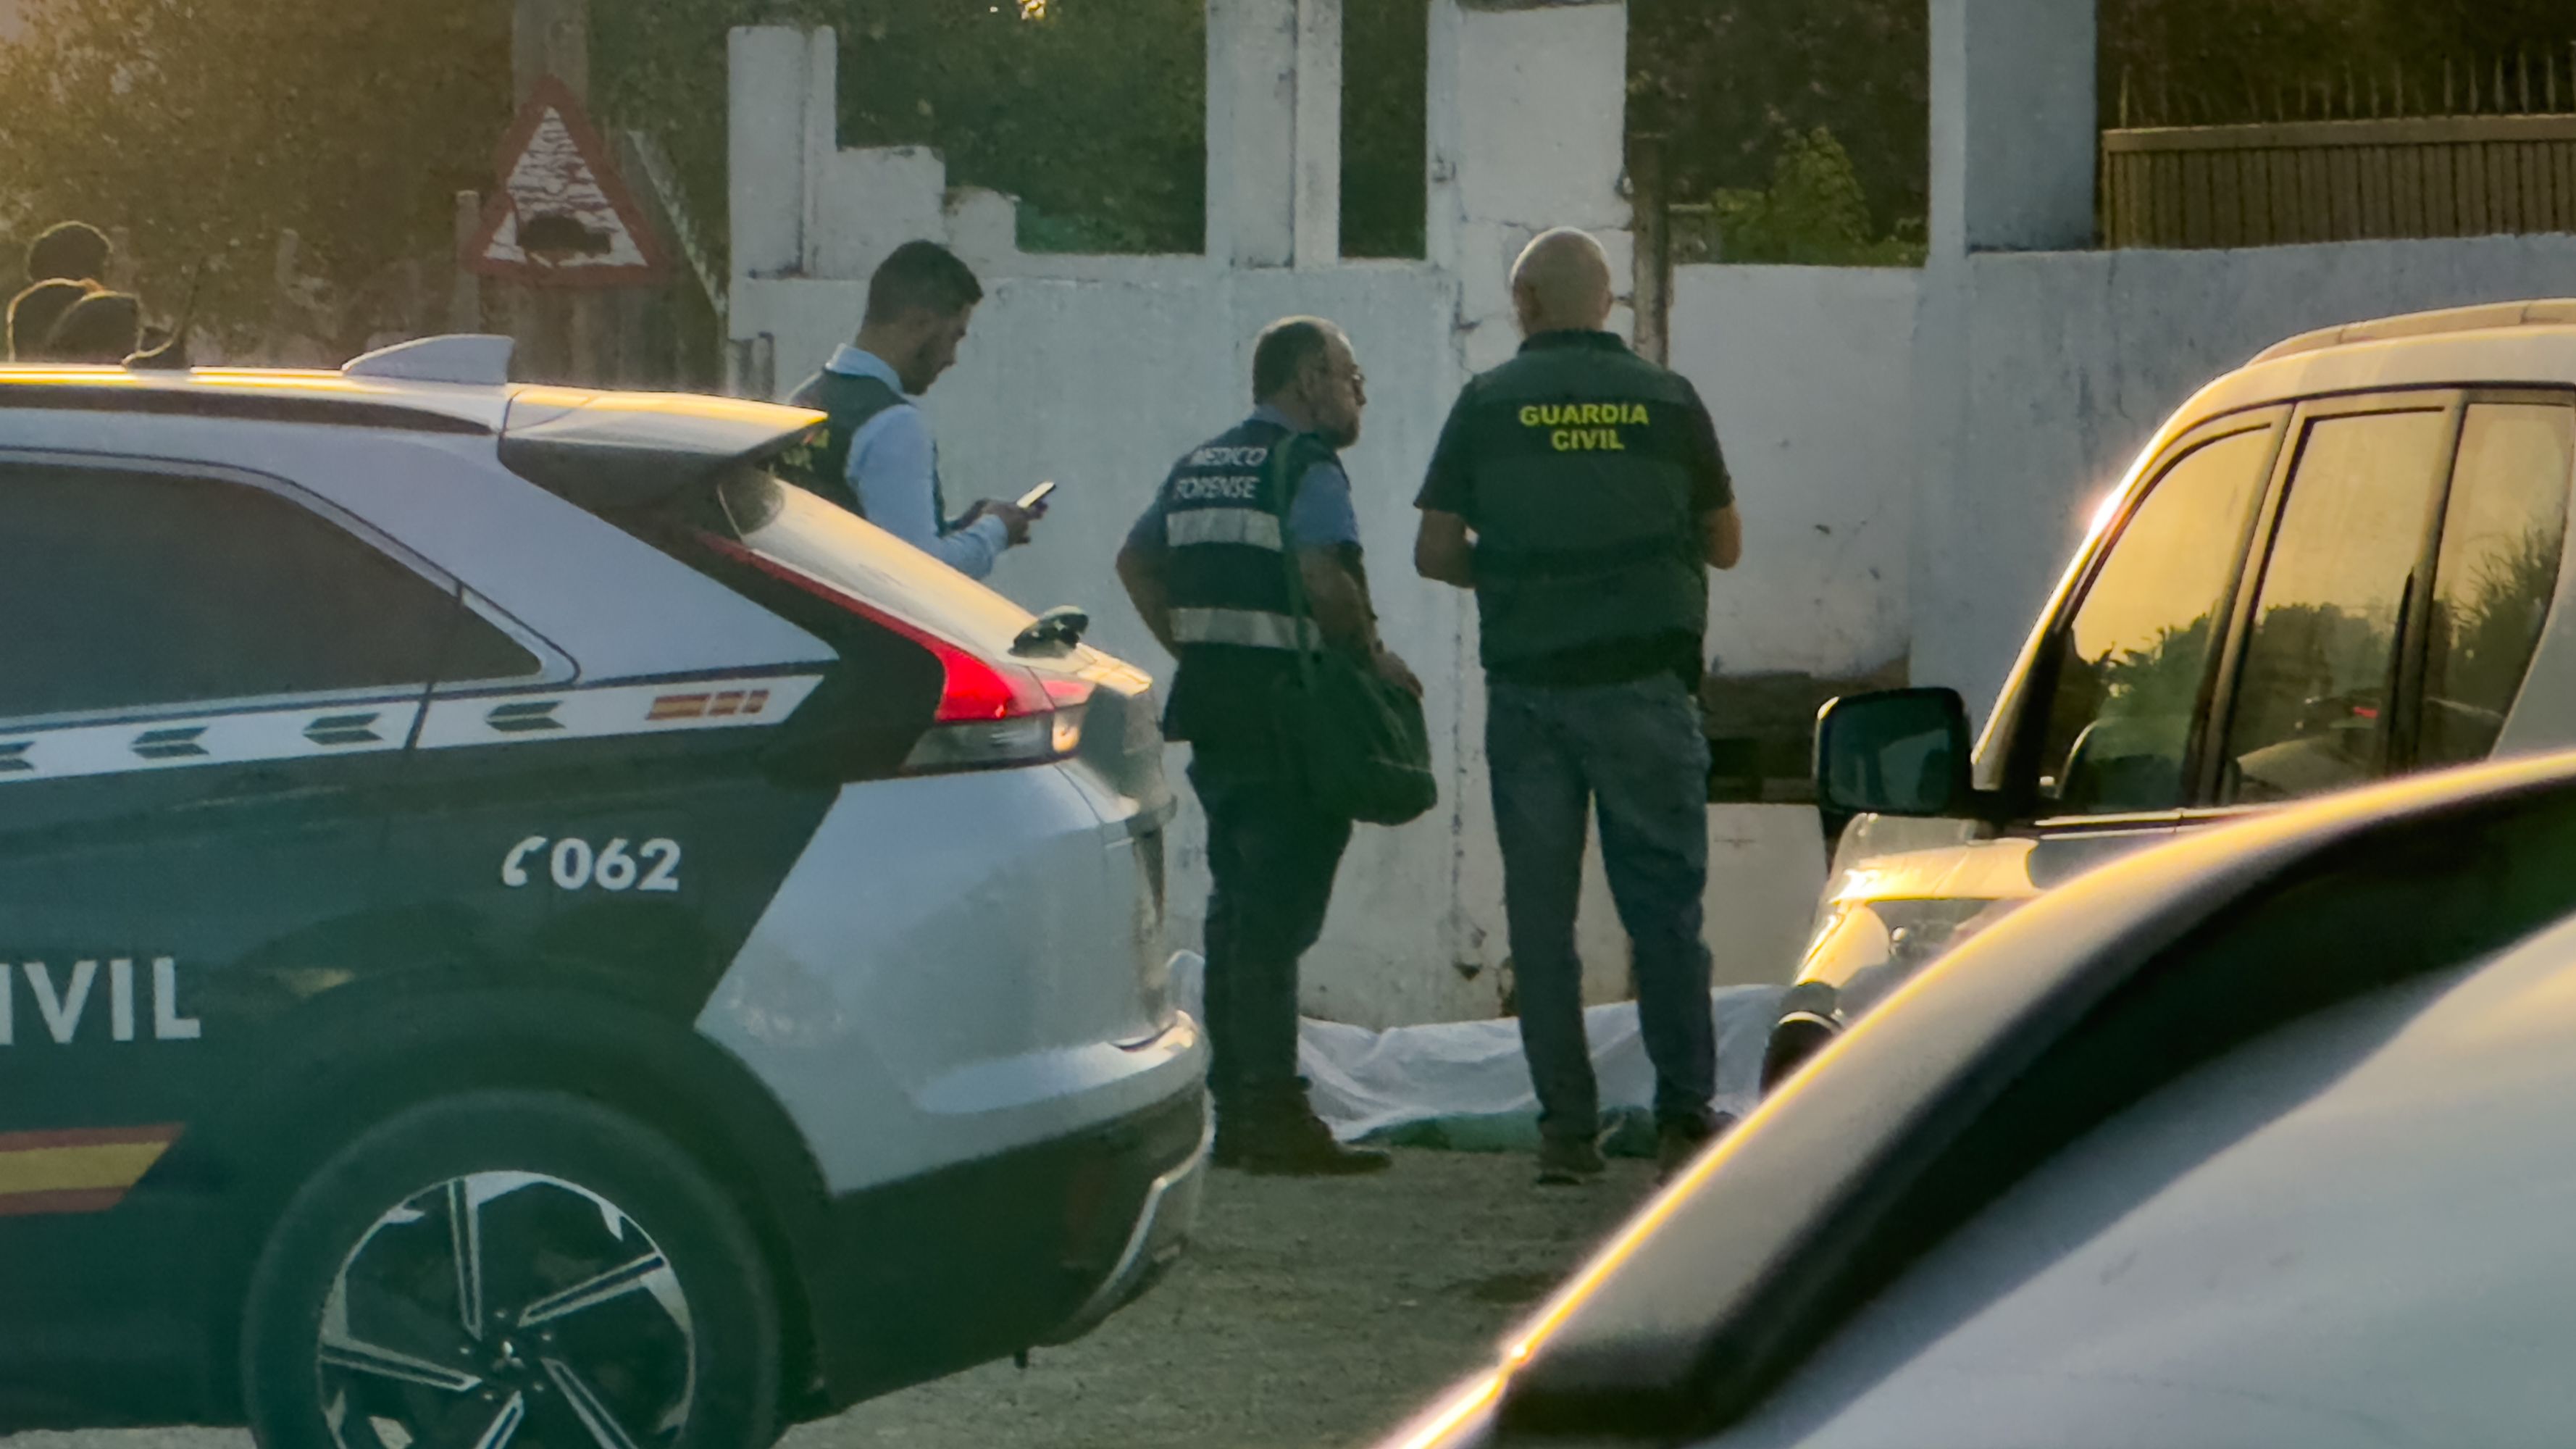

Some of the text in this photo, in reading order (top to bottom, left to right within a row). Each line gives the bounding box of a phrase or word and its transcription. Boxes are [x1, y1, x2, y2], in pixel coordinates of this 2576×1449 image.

[1519, 404, 1649, 426] GUARDIA
[1551, 429, 1625, 451] CIVIL
[1172, 475, 1261, 500] FORENSE
[551, 837, 682, 892] 062
